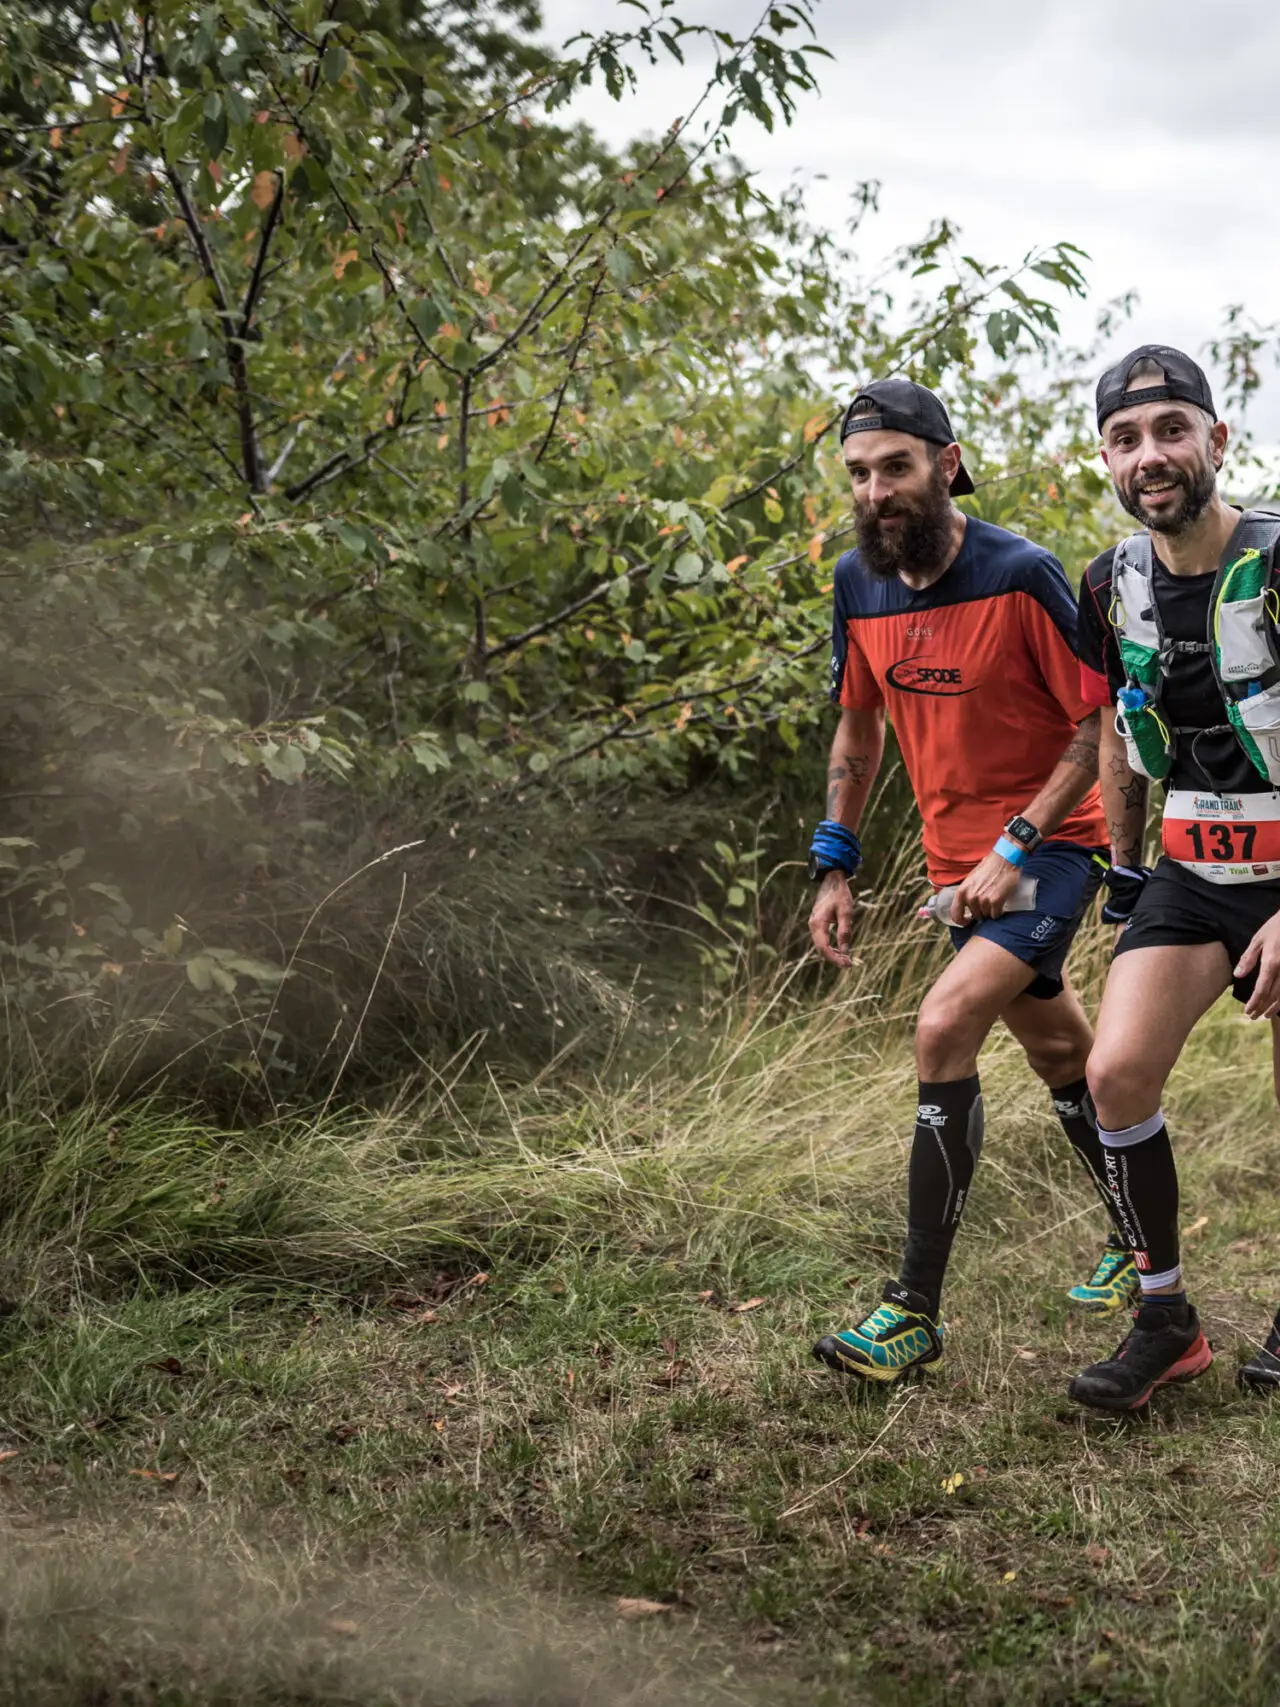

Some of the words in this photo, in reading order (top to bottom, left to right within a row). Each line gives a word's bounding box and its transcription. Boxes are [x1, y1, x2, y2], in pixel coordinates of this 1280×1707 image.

[1196, 799, 1220, 810] GRAND
[1220, 800, 1240, 811] TRAIL
[1185, 823, 1257, 861] 137
[1228, 867, 1249, 875] Trail
[1030, 915, 1054, 940] GORE
